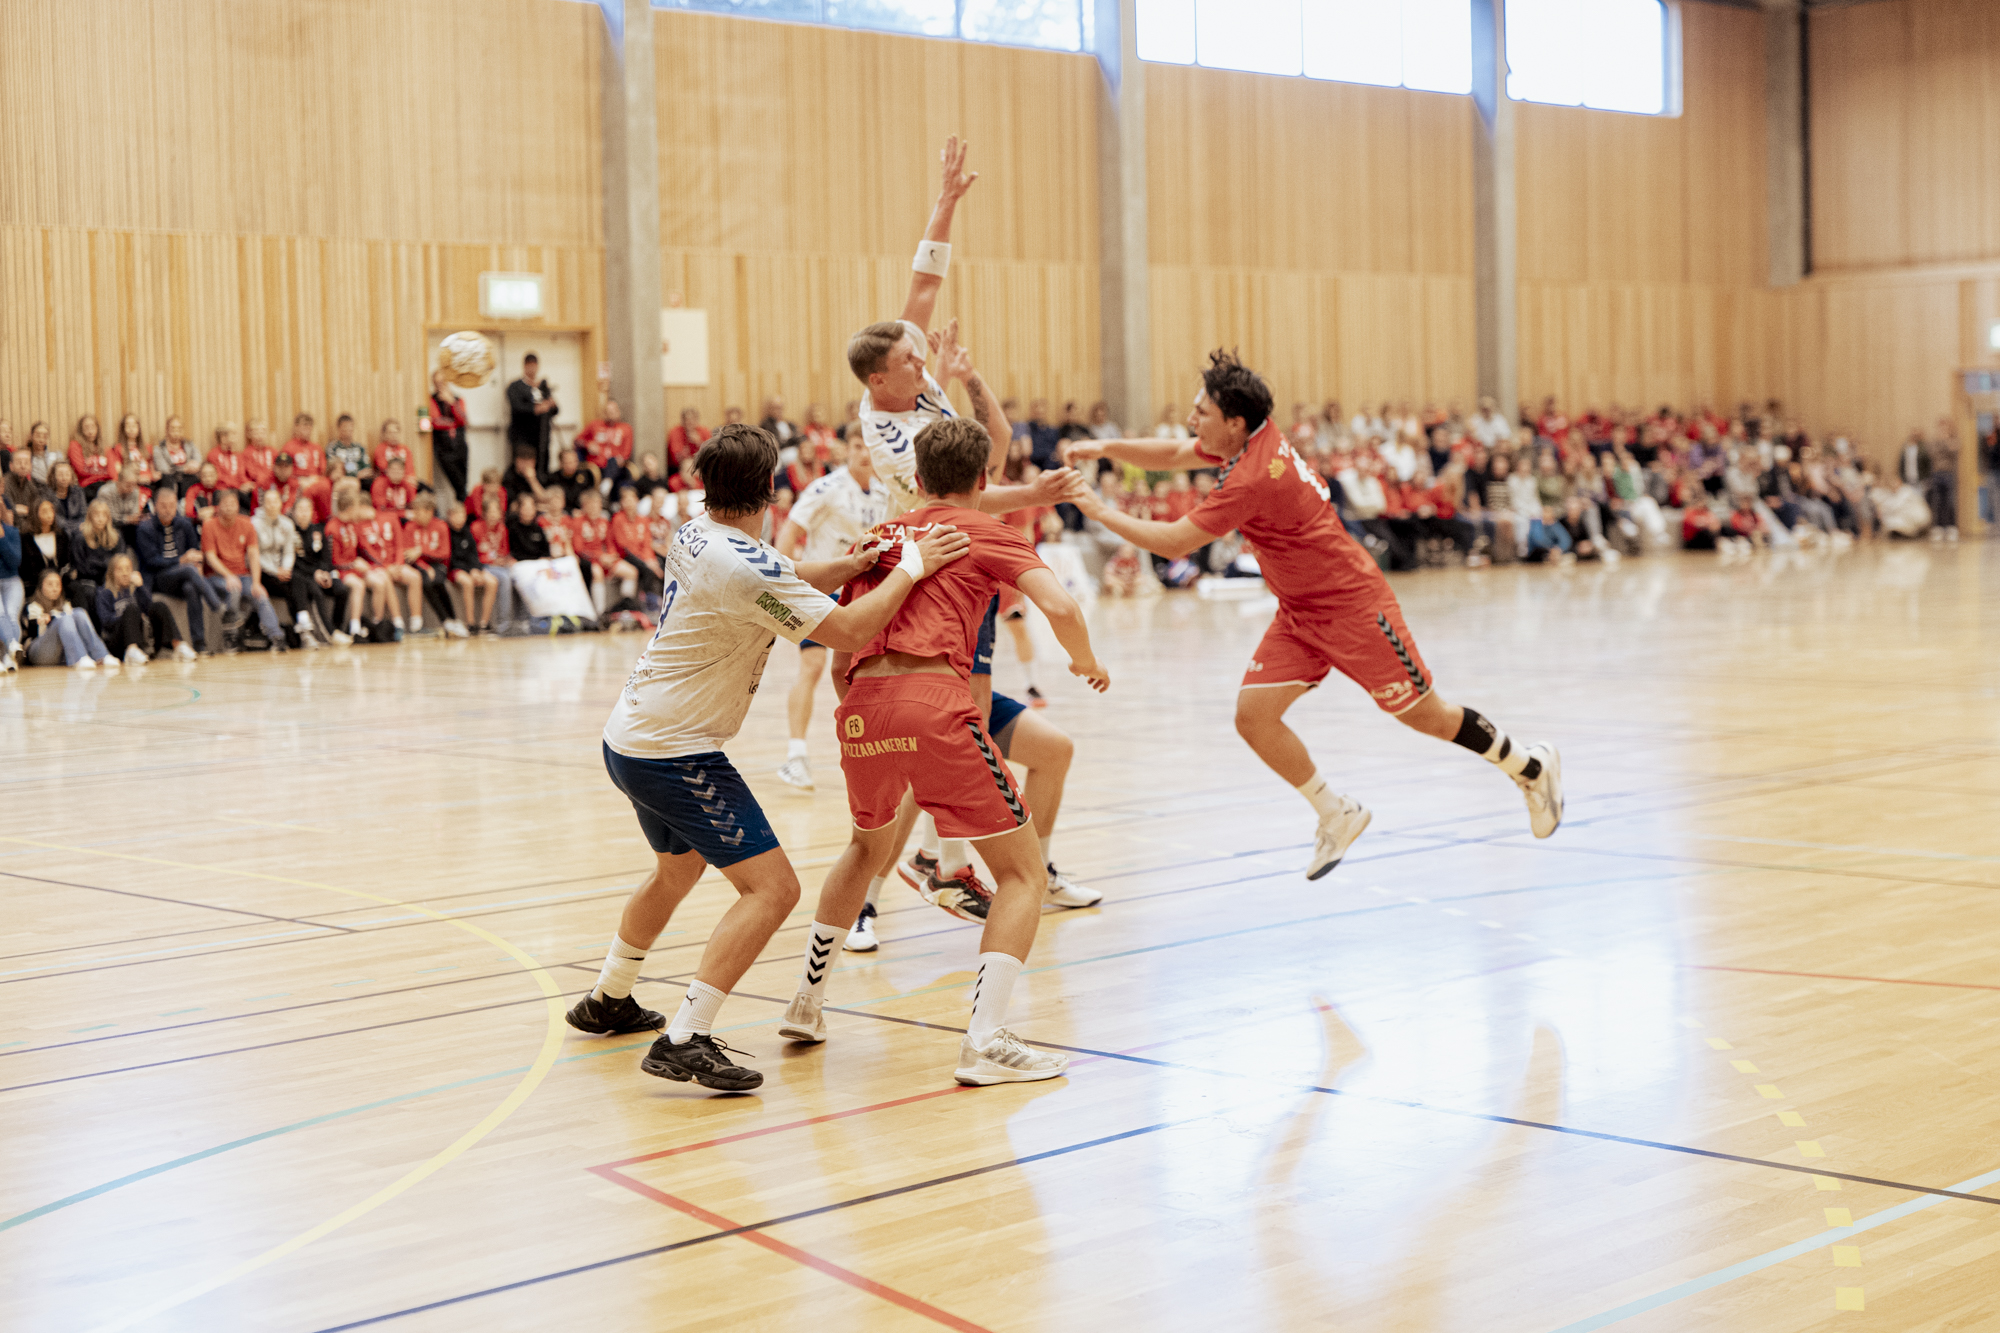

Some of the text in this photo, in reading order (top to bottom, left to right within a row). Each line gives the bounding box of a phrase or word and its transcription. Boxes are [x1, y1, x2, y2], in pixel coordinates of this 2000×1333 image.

[755, 591, 792, 622] KIWI
[783, 620, 797, 631] pris
[789, 615, 805, 627] mini
